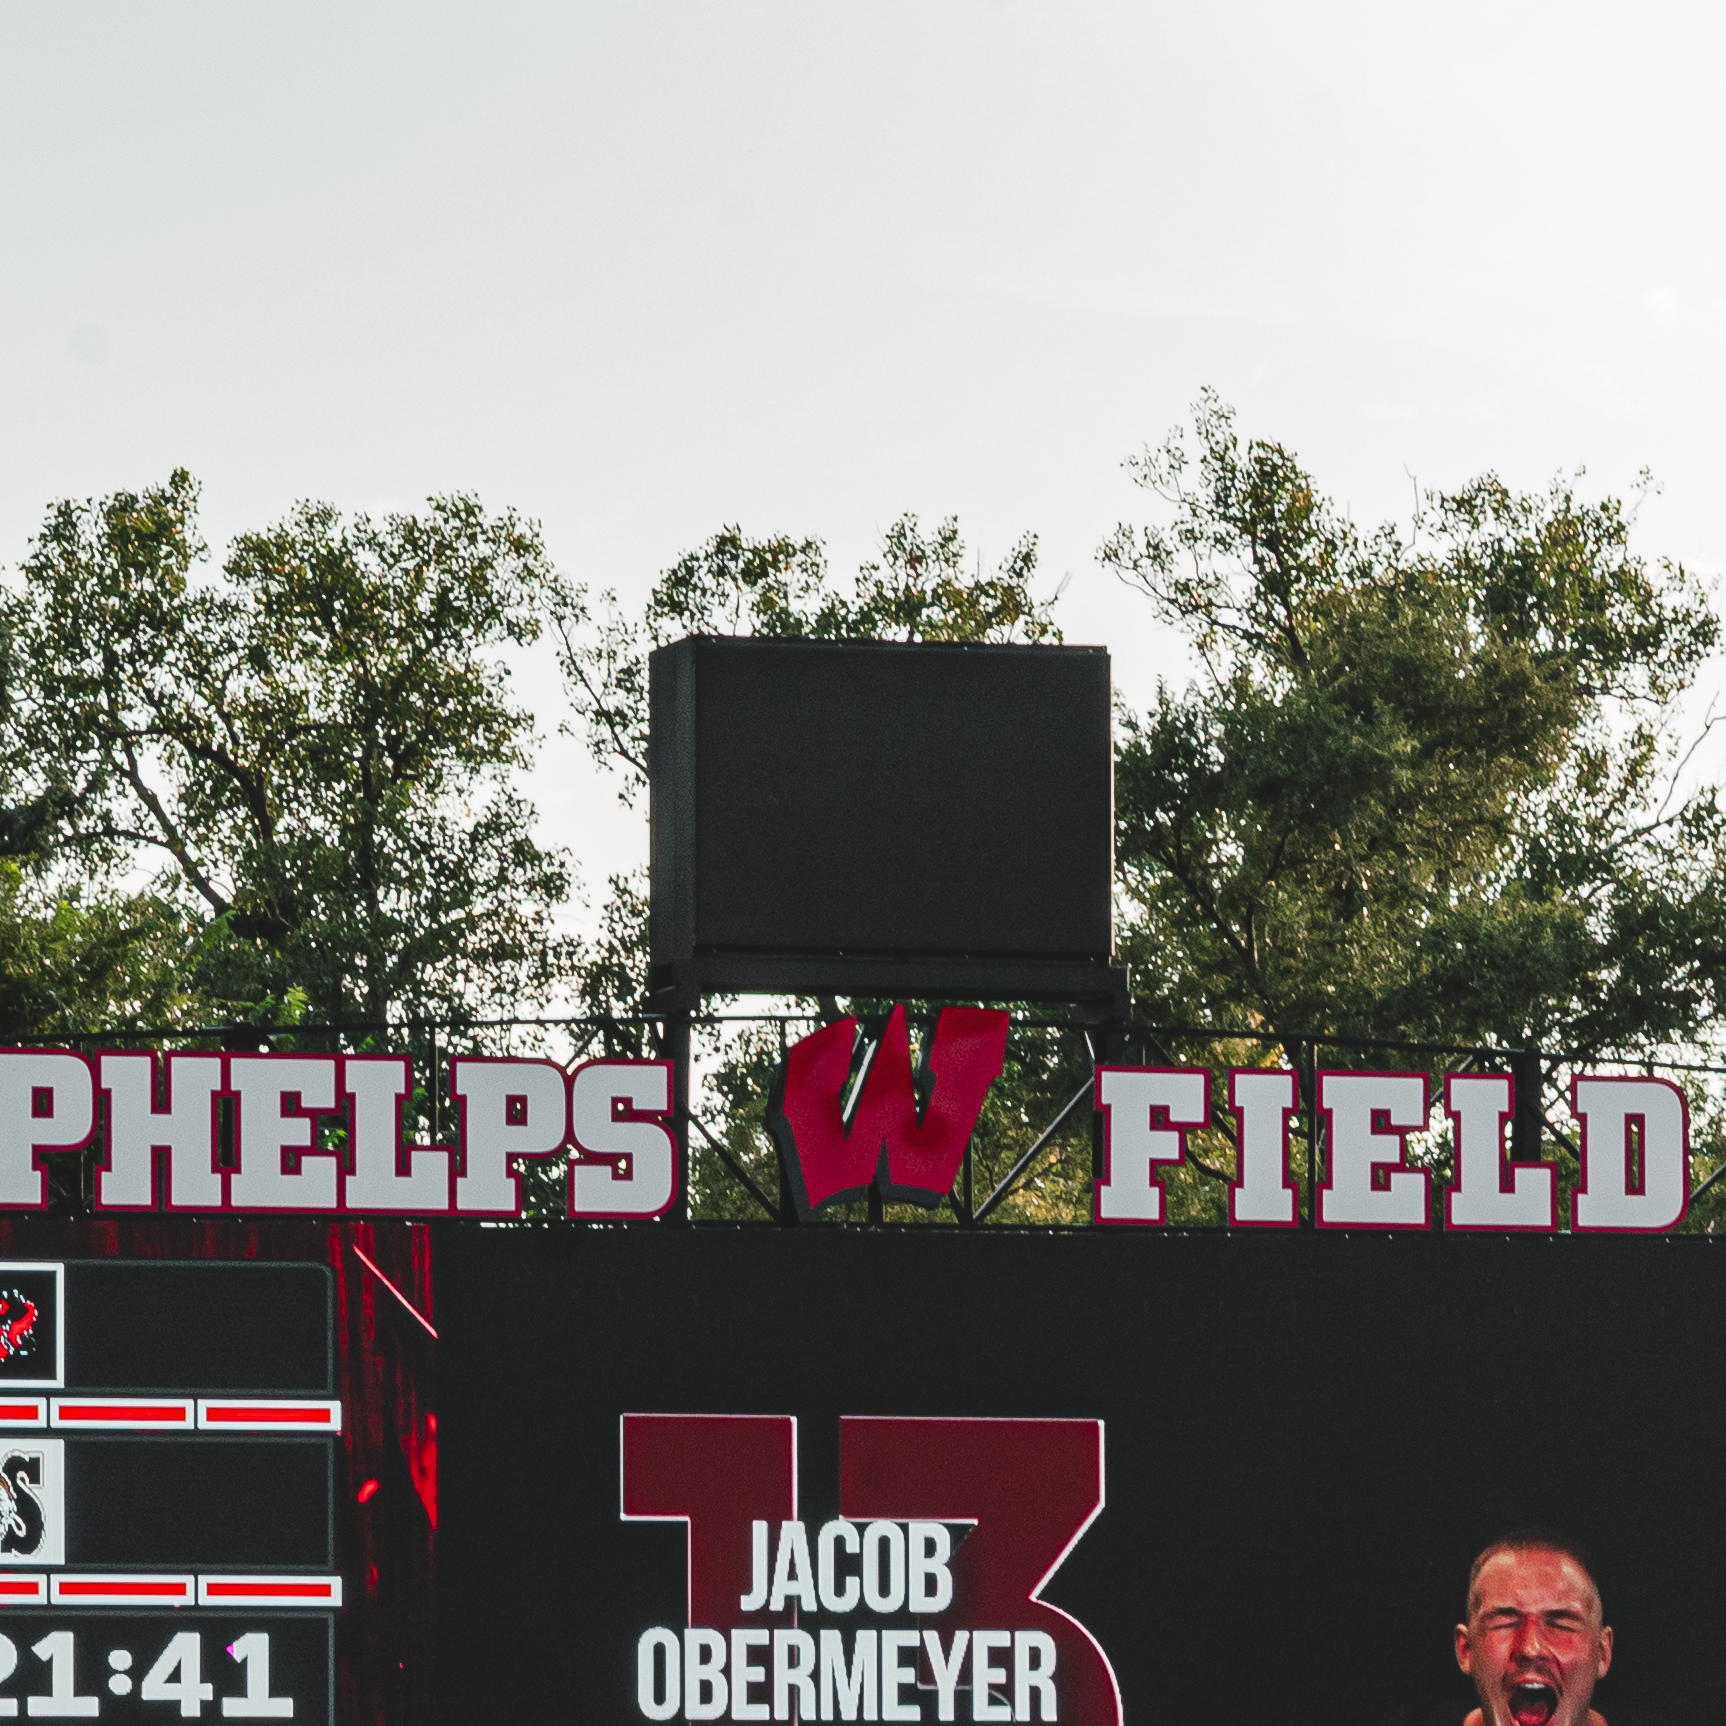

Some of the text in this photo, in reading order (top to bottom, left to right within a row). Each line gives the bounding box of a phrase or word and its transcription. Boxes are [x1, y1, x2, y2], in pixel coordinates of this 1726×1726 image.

[780, 1004, 1010, 1208] W
[1094, 1064, 1687, 1231] FIELD
[739, 1519, 953, 1613] JACOB
[637, 1626, 1058, 1722] OBERMEYER
